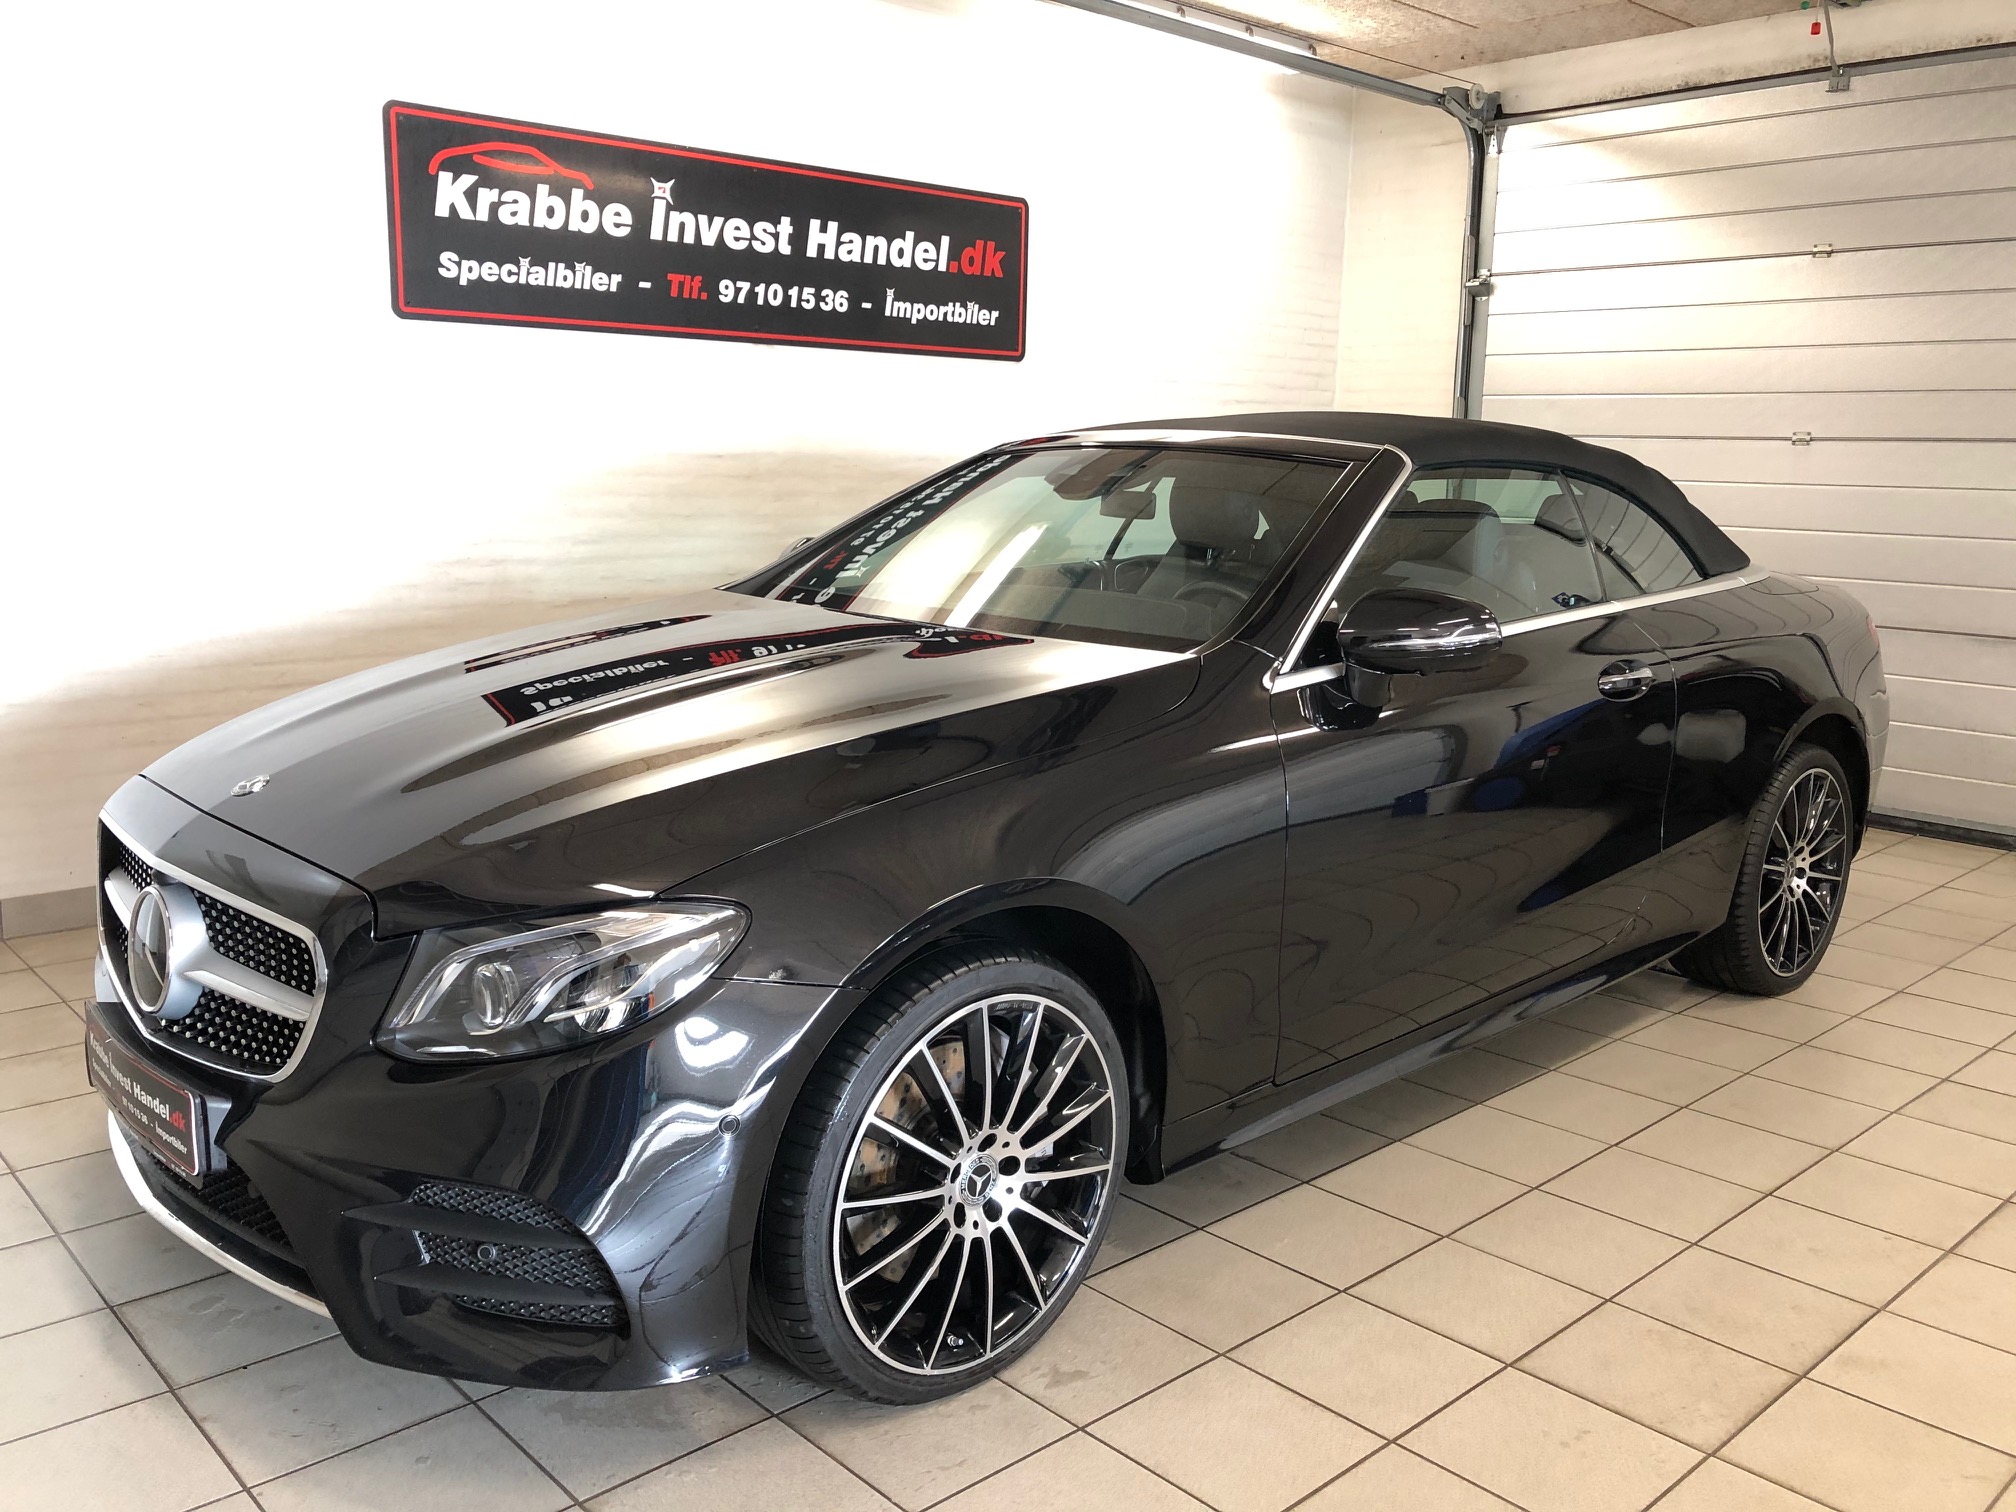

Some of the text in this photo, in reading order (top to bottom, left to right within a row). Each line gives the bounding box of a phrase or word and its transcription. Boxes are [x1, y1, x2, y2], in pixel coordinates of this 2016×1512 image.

[434, 170, 633, 238] Krabbe
[650, 177, 794, 256] Invest
[437, 251, 623, 293] Specialbiler
[666, 273, 708, 300] Tlf.
[885, 288, 1000, 326] Importbiler
